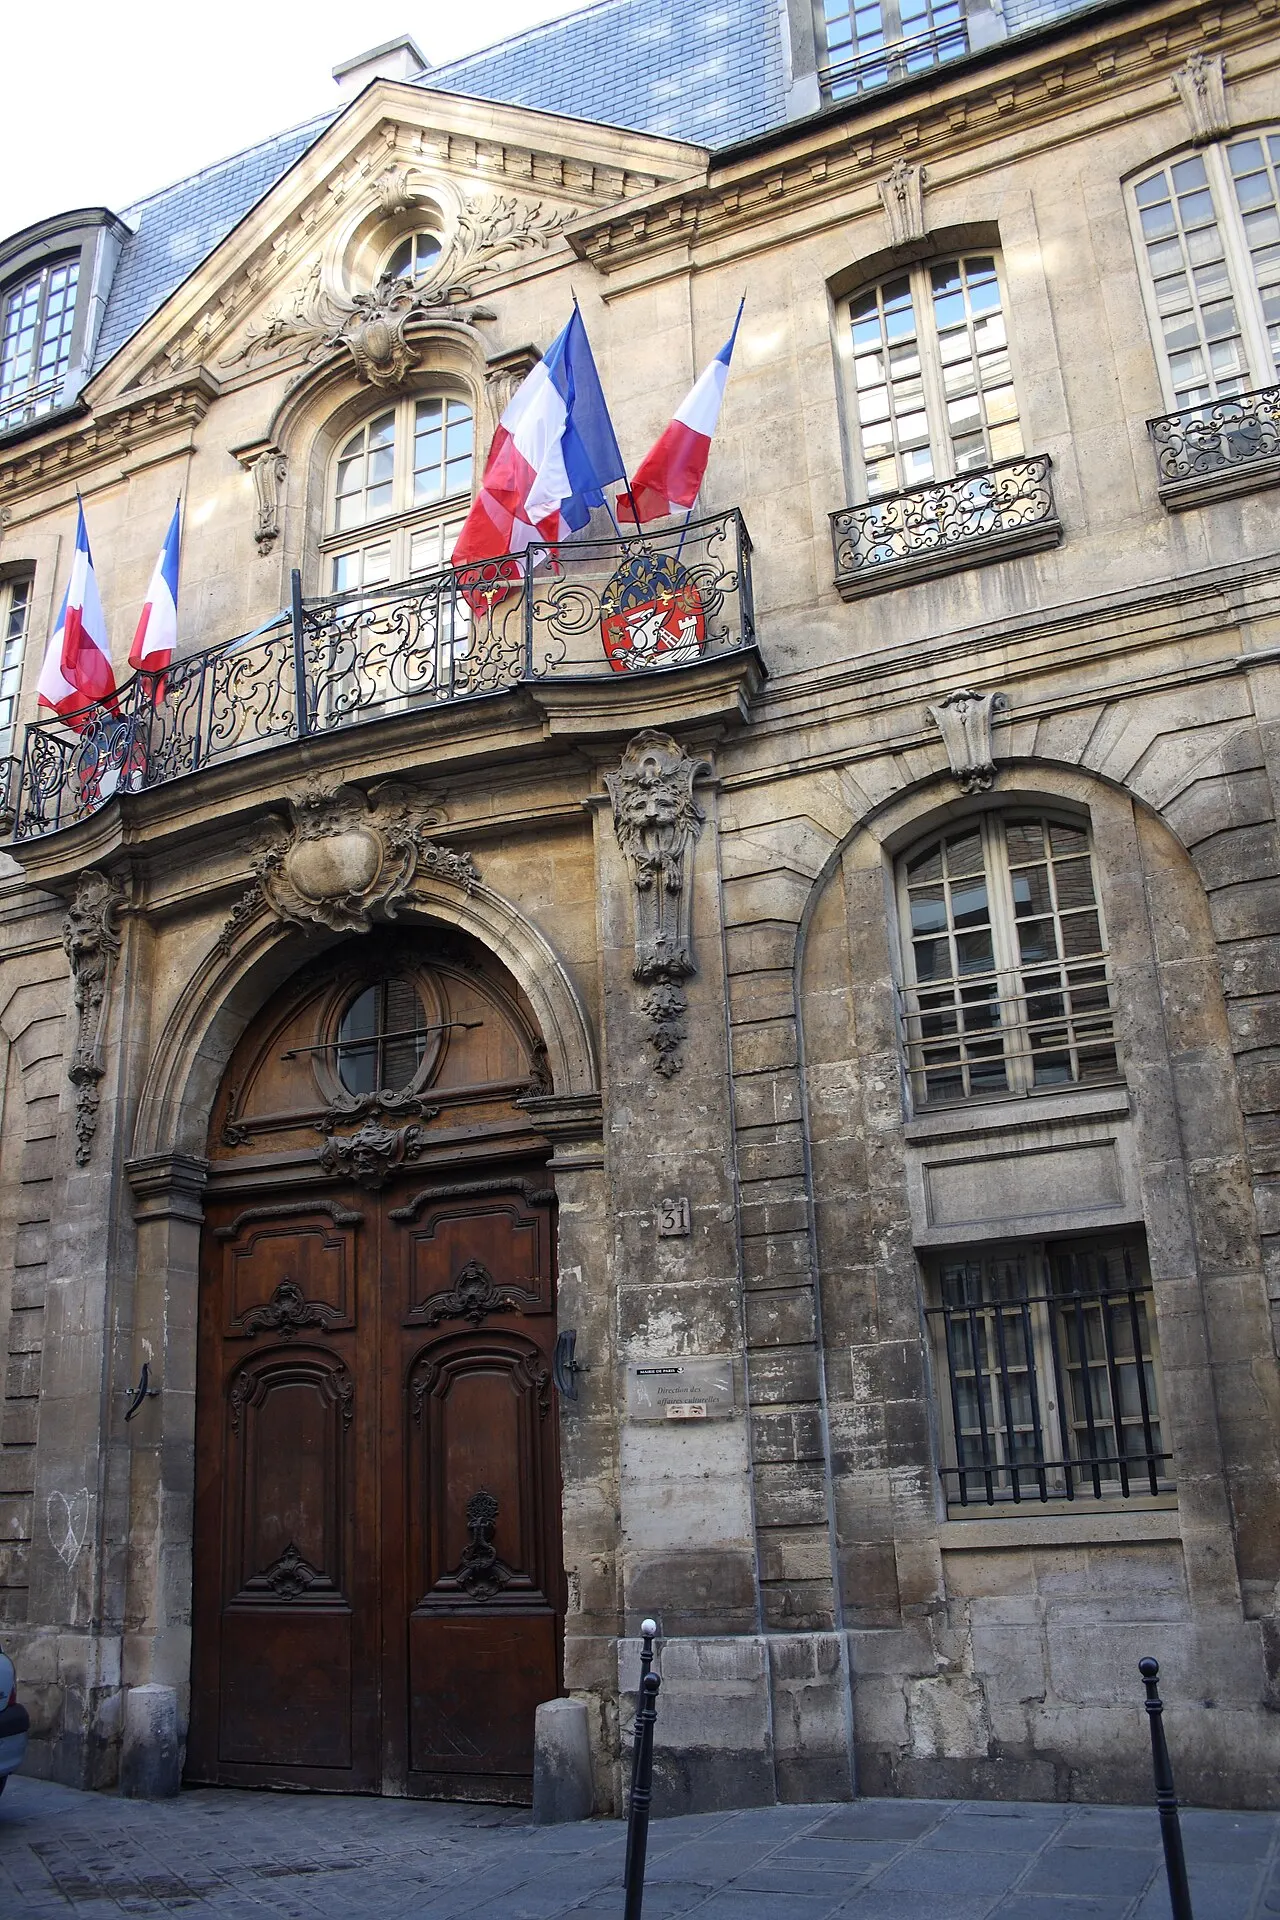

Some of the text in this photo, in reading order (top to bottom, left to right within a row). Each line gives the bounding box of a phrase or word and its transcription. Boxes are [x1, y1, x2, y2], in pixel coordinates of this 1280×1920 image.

[662, 1209, 687, 1229] 31
[657, 1386, 689, 1394] Direction
[657, 1396, 720, 1406] affaires culturelles
